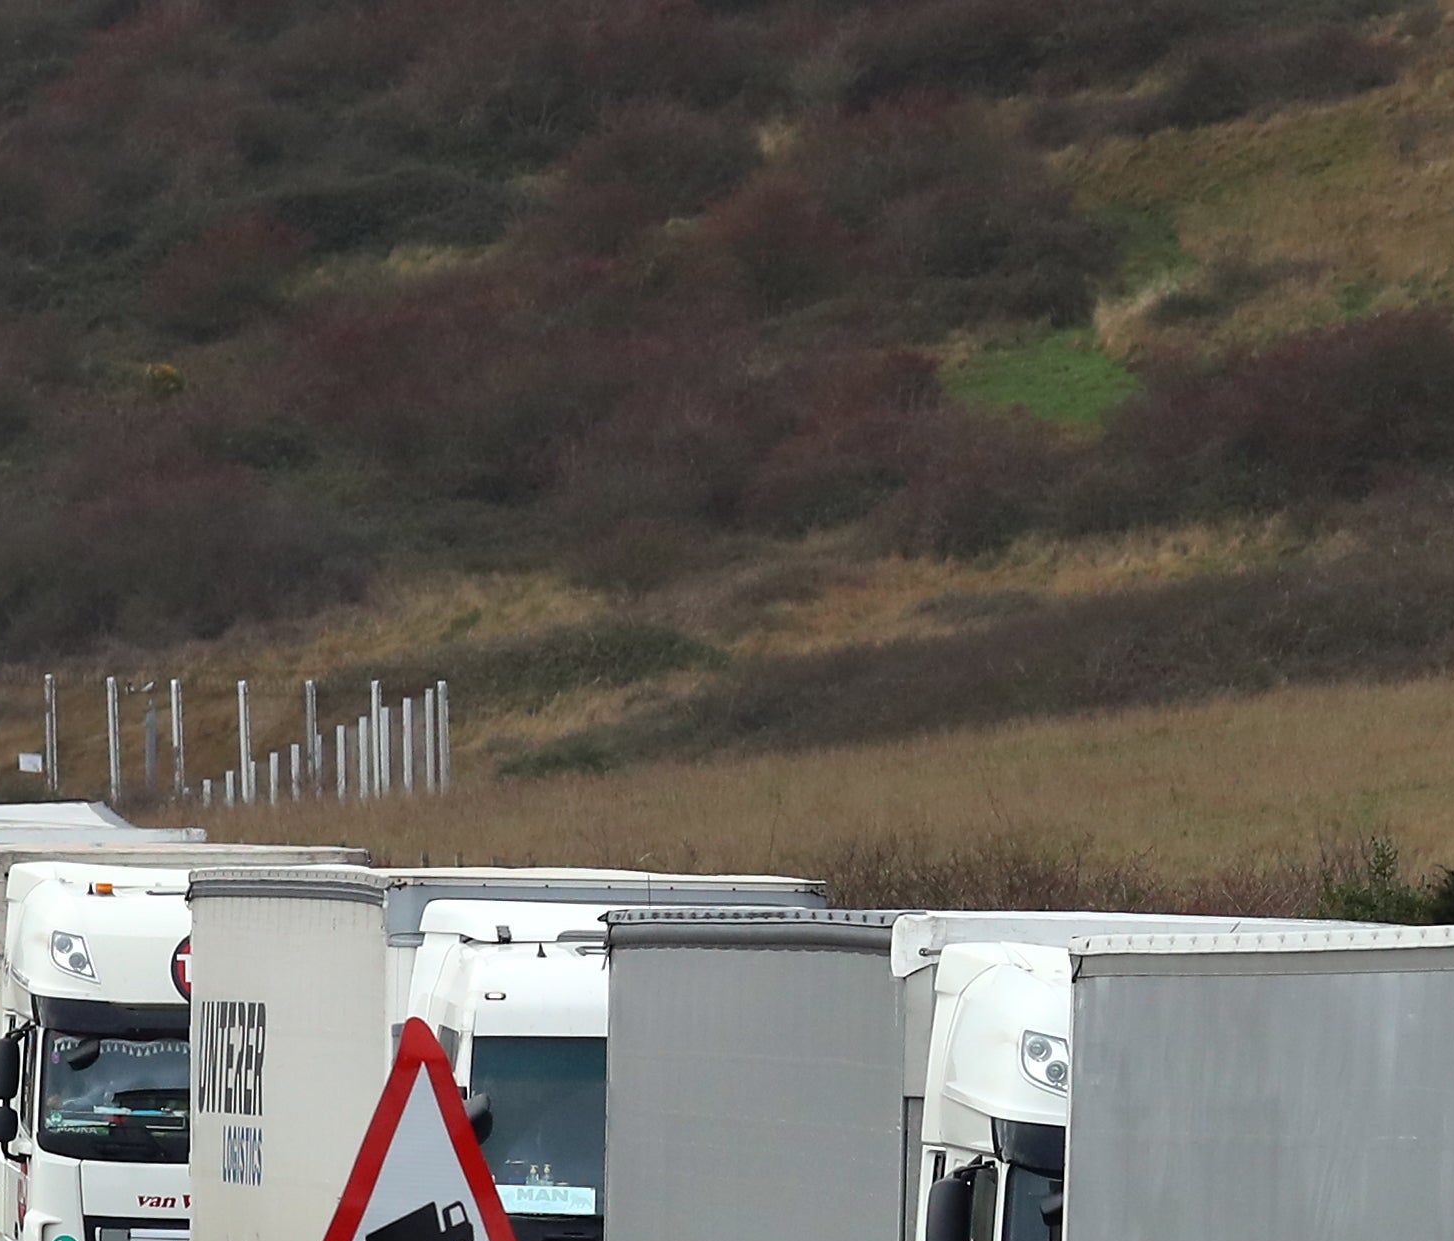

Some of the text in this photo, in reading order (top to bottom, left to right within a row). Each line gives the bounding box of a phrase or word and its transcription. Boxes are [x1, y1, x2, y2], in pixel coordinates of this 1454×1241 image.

[198, 1001, 266, 1116] UNTERER
[222, 1125, 263, 1187] LOGISTICS
[138, 1195, 177, 1208] van
[516, 1188, 569, 1201] MAN
